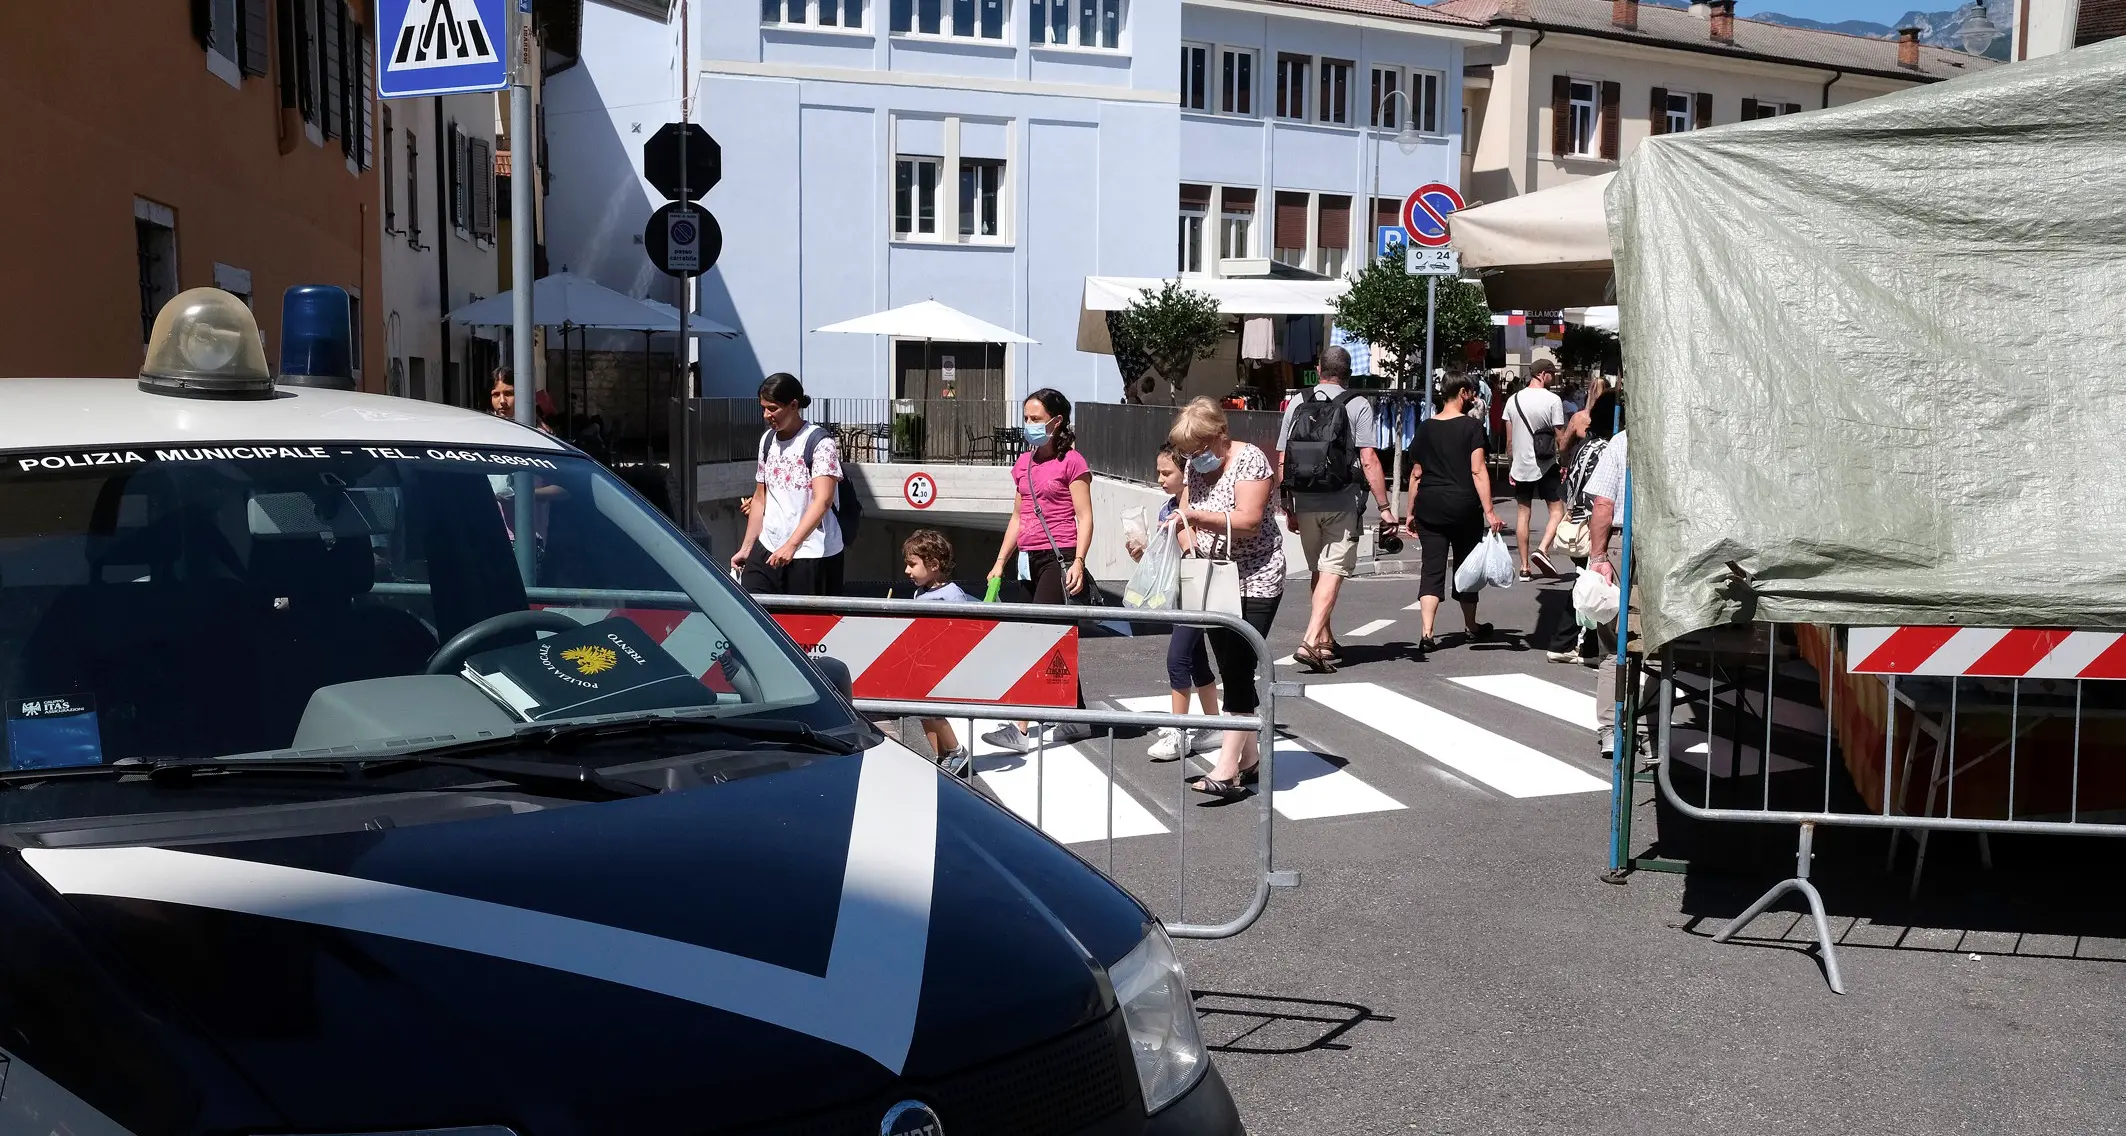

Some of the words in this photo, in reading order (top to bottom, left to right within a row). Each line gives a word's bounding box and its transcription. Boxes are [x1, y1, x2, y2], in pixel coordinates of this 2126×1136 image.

[1384, 230, 1402, 253] P
[1436, 251, 1450, 260] 24
[1544, 310, 1564, 318] MODA
[18, 451, 146, 472] POLIZIA
[154, 446, 331, 462] MUNICIPALE
[360, 446, 420, 460] TEL.
[426, 449, 558, 470] 0461.889111
[539, 643, 555, 671] LOCALE
[607, 633, 646, 665] TRENTO
[553, 669, 599, 689] POLIZIA
[44, 701, 70, 711] ITAS
